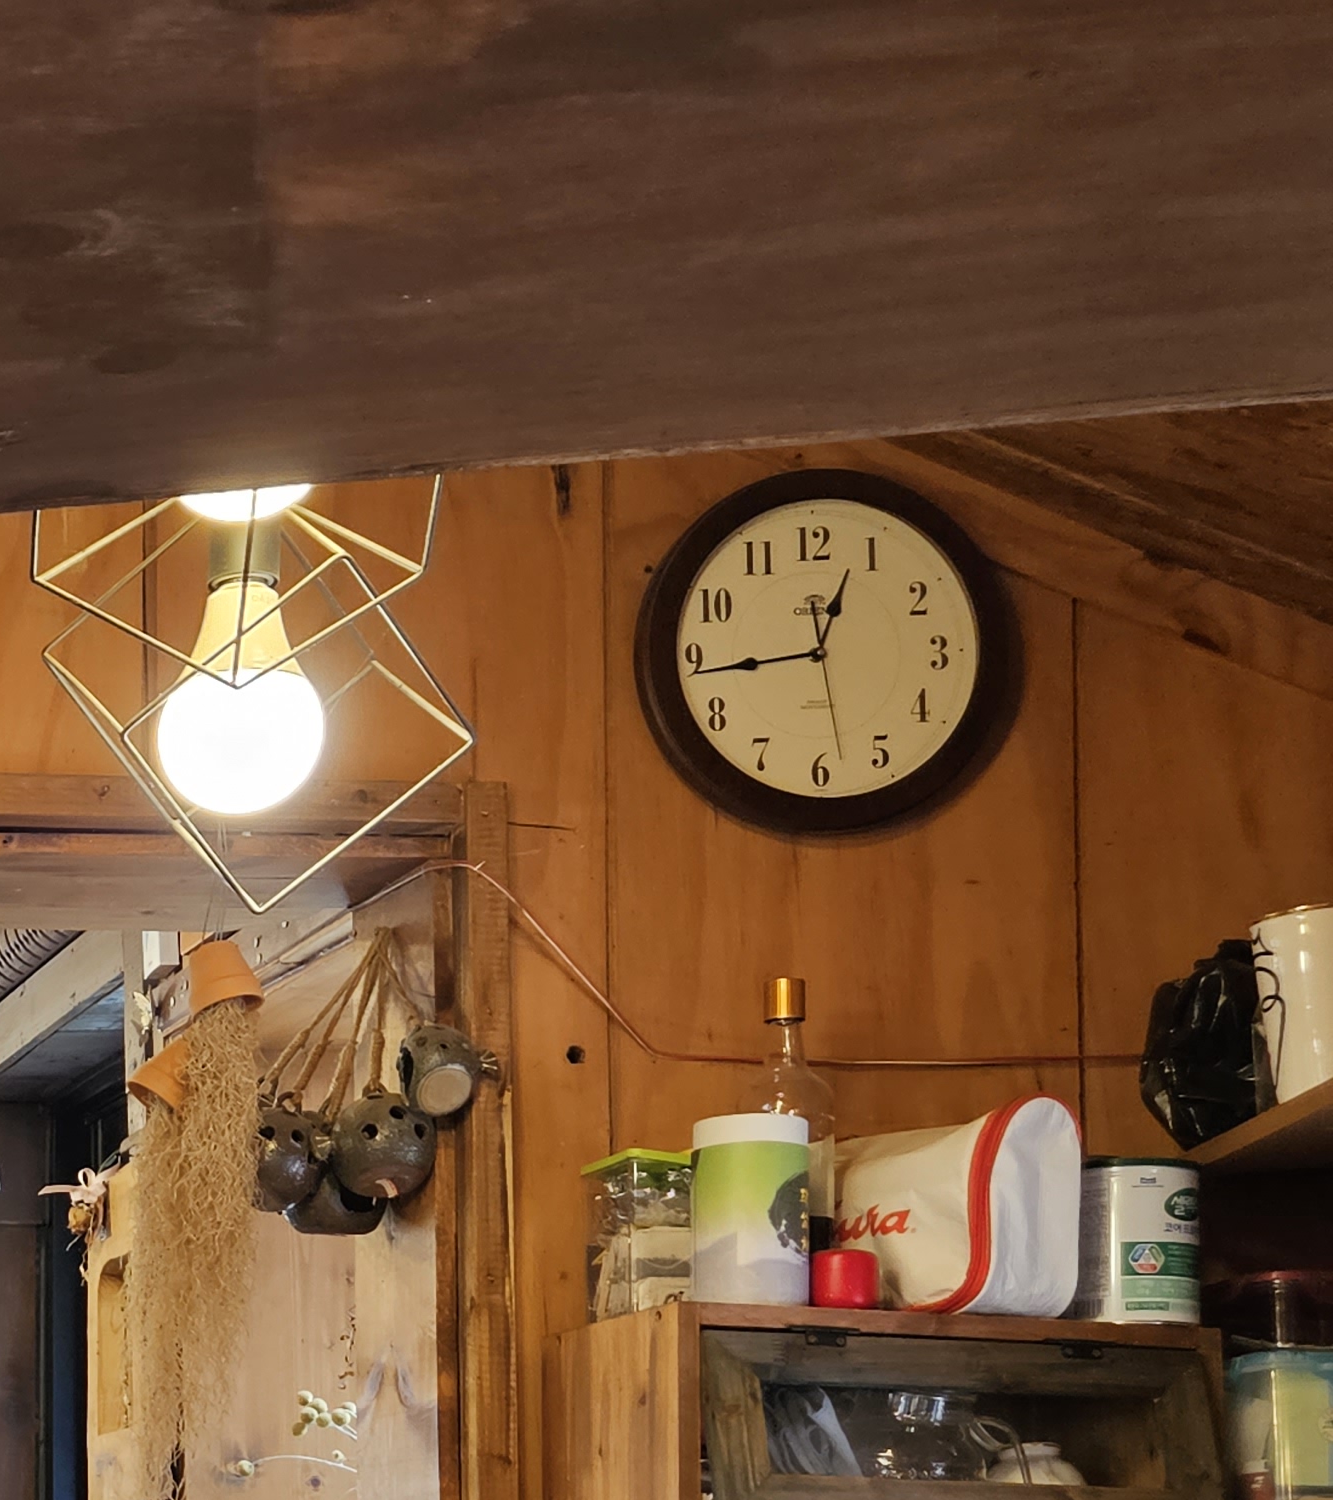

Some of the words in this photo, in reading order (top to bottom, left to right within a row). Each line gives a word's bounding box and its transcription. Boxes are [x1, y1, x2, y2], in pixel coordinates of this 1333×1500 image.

[743, 541, 776, 575] 11
[796, 526, 831, 562] 12
[865, 537, 879, 571] 1
[698, 588, 732, 623] 10
[909, 581, 928, 615] 2
[685, 643, 703, 677] 9
[930, 635, 950, 670] 3
[708, 697, 726, 731] 8
[911, 688, 931, 723] 4
[751, 737, 770, 771] 7
[871, 735, 890, 768] 5
[812, 752, 830, 787] 6
